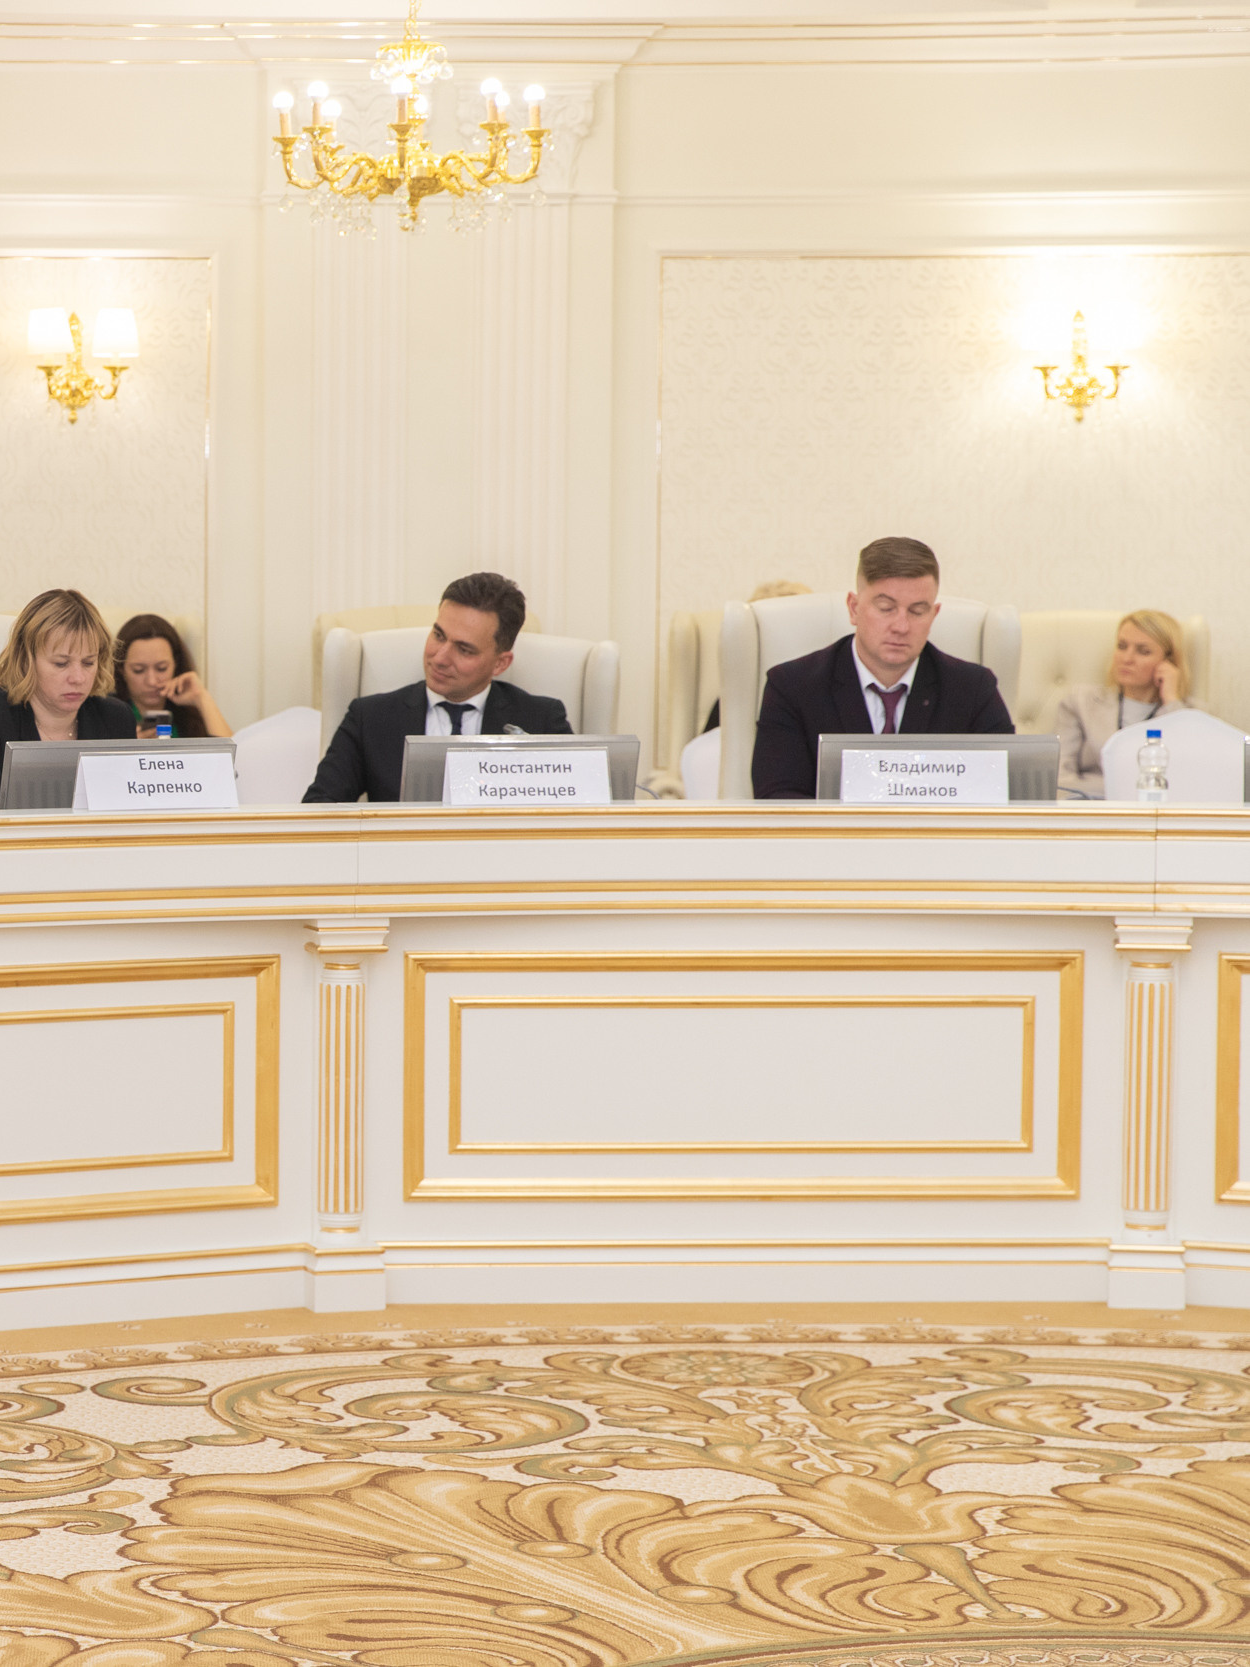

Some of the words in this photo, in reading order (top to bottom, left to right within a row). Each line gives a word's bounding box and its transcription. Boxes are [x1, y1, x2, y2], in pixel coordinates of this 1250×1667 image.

[138, 757, 185, 771] Елена
[478, 761, 572, 774] Константин
[878, 759, 966, 776] Владимир
[127, 781, 203, 797] Карпенко
[478, 784, 577, 800] Караченцев
[887, 783, 958, 797] Шмаков
